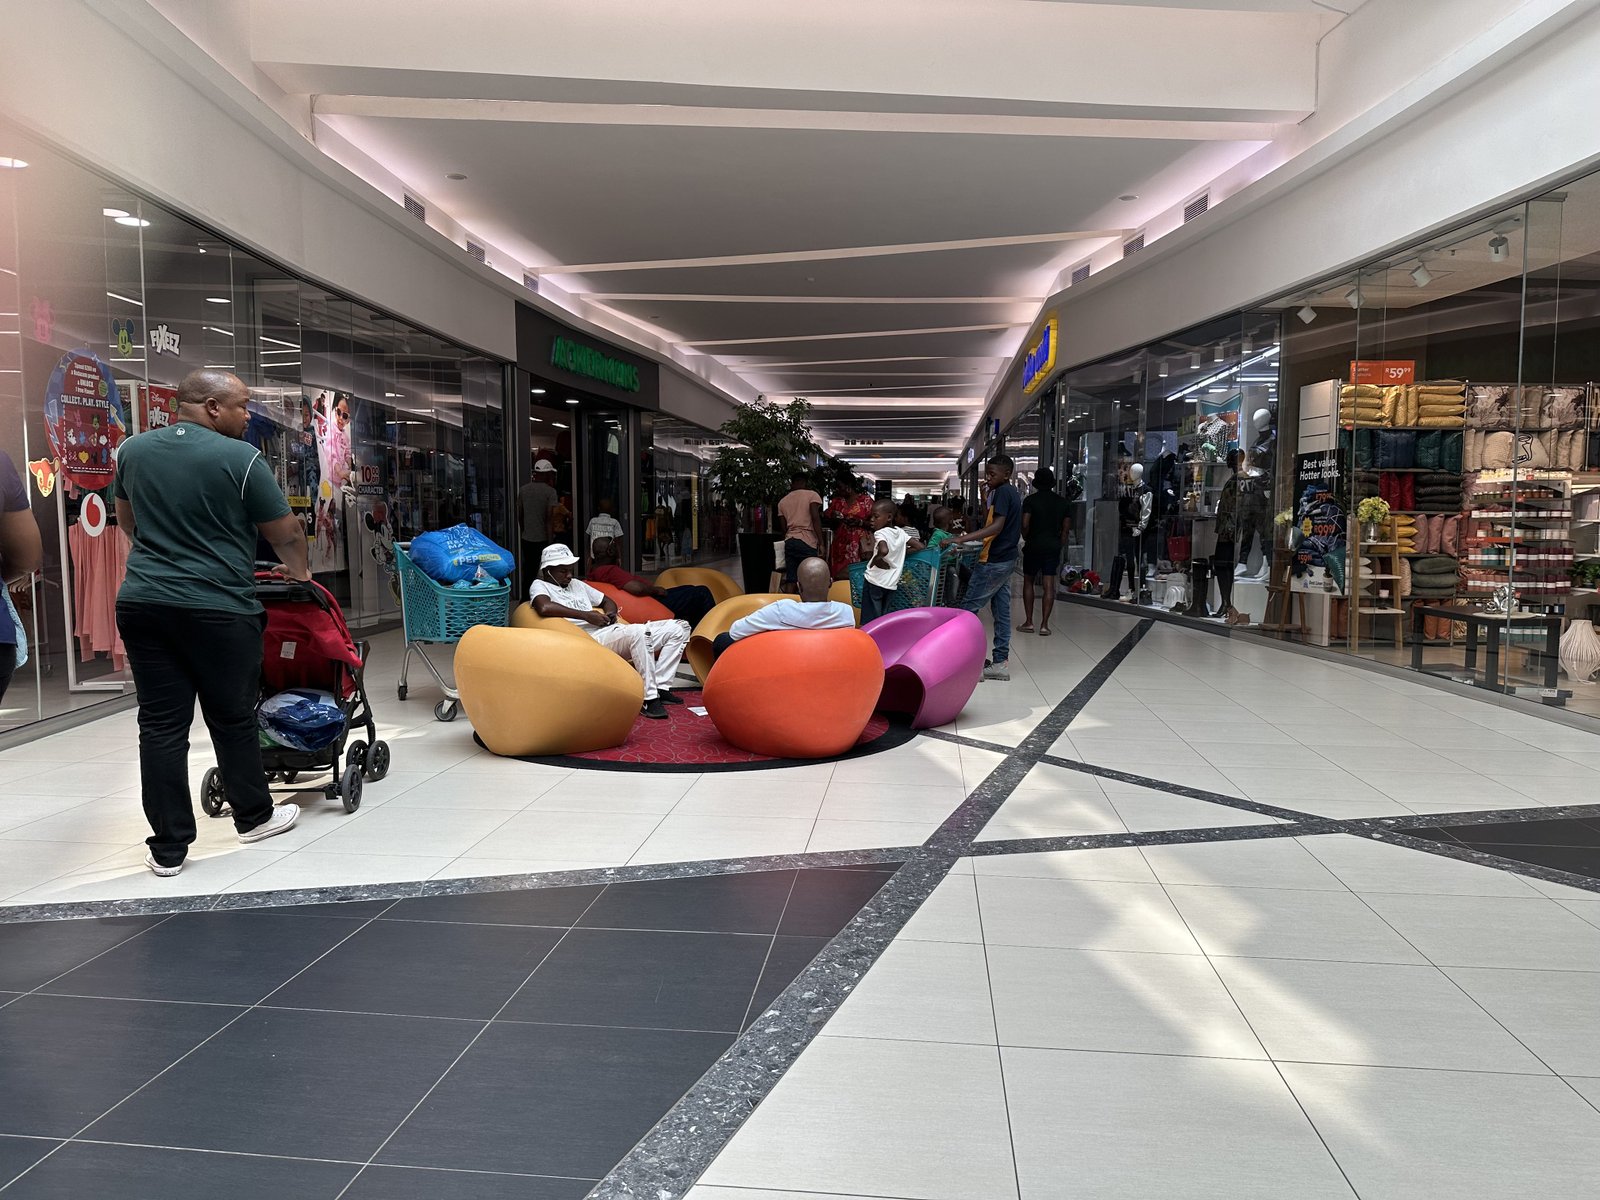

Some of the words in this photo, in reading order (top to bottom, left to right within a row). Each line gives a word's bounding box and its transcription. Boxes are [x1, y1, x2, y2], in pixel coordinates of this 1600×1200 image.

[149, 324, 180, 355] FIXEEZ
[95, 399, 110, 409] STYLE
[1303, 459, 1317, 470] Best
[1318, 457, 1337, 468] value.
[1300, 471, 1321, 481] Hotter
[1321, 468, 1341, 478] looks.
[358, 485, 384, 495] CHARACTER
[459, 555, 479, 566] PEP
